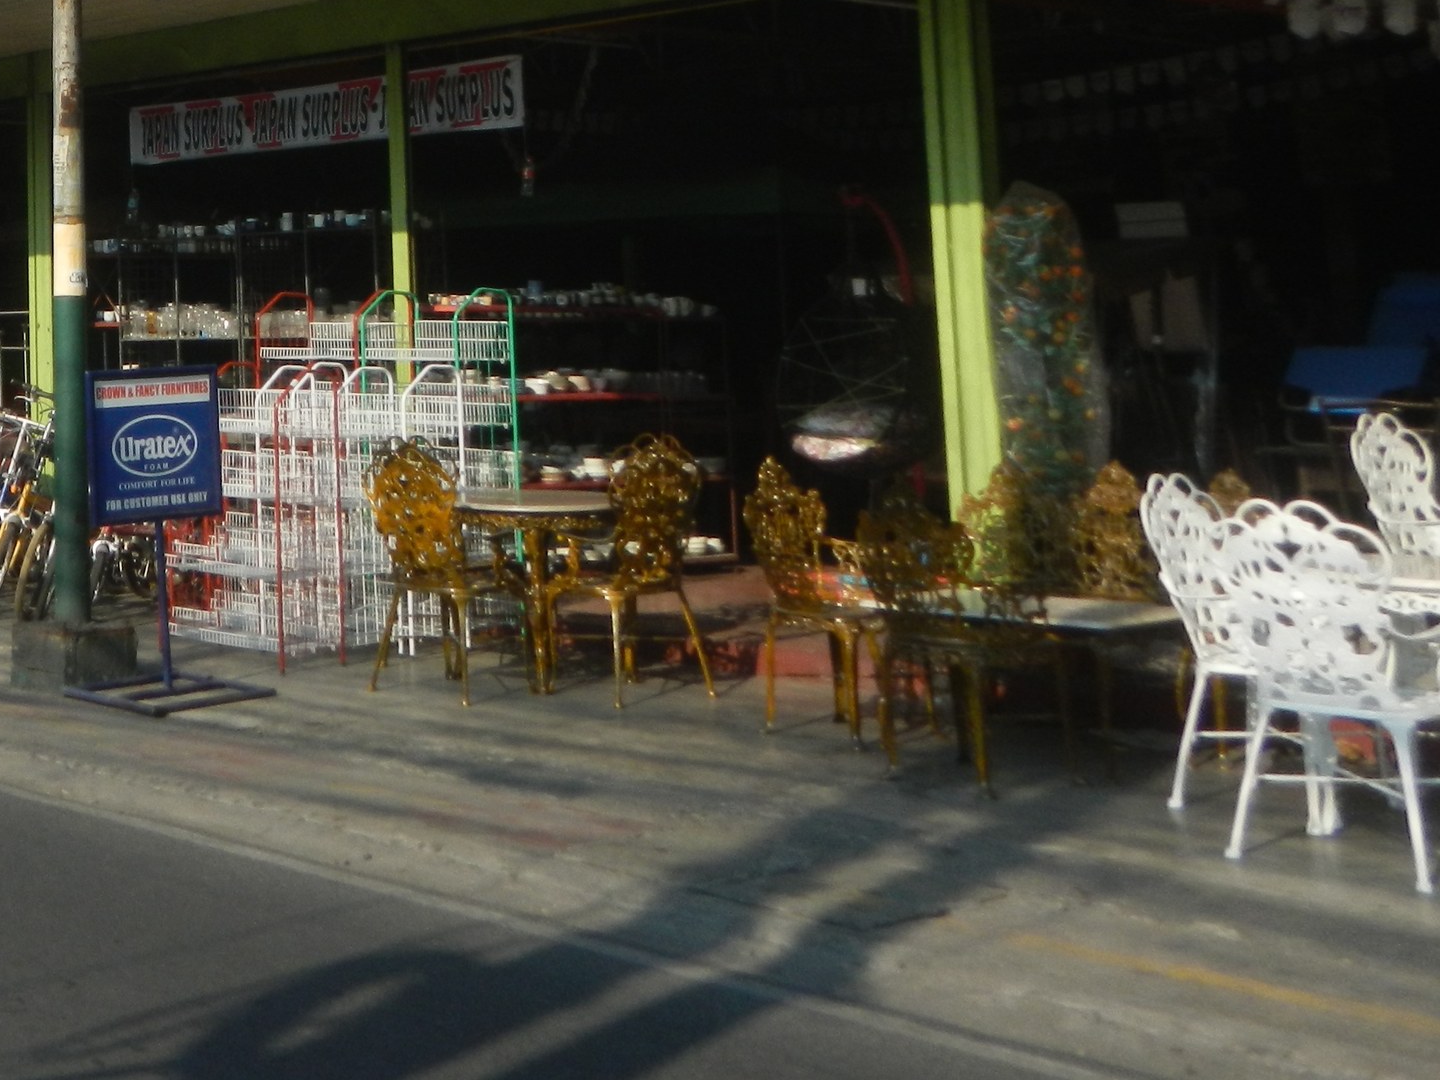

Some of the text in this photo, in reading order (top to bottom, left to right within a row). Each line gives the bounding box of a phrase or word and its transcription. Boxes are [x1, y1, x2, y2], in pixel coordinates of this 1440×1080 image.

[141, 67, 515, 157] JAPAN SURPLUS JAPAN SURPLUS JAN SURPLUS
[96, 380, 209, 400] CROWN & FANCY FURNITURES
[143, 462, 169, 471] FOAM
[118, 476, 196, 491] COMFORT FOR LIFE
[106, 491, 208, 512] FOR CUSTOMER USE ONLY
